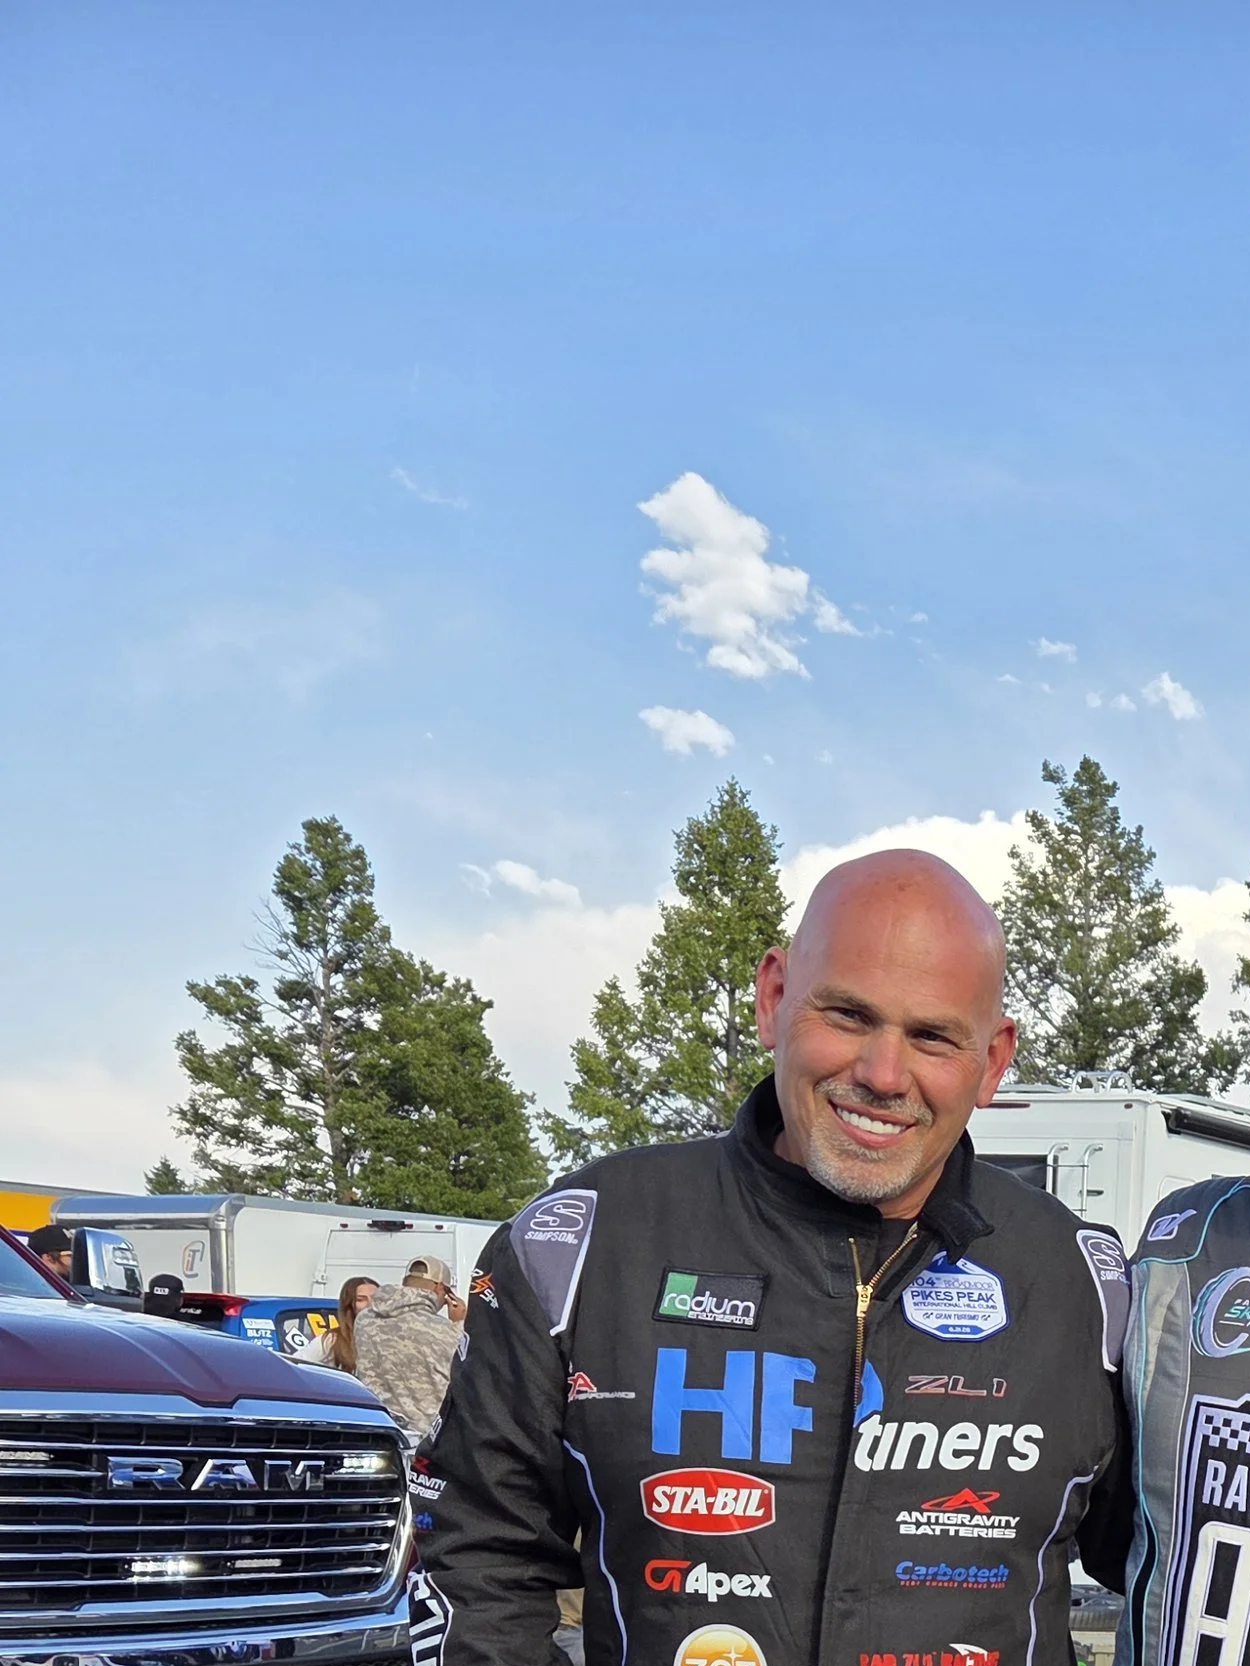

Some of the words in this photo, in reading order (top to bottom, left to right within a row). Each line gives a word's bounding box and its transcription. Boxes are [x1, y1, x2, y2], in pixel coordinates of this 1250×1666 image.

[524, 1231, 574, 1244] SIMPSON
[664, 1291, 756, 1317] radium
[910, 1290, 954, 1301] PIKES
[956, 1292, 996, 1304] PEAK
[912, 1301, 962, 1309] INTERNATIONAL
[106, 1456, 326, 1491] RAM
[652, 1485, 766, 1517] STA-BIL
[895, 1510, 1020, 1527] ANTIGRAVITY
[899, 1524, 1017, 1539] BATTERIES
[895, 1561, 1010, 1583] Carbotech
[685, 1562, 773, 1602] Apex
